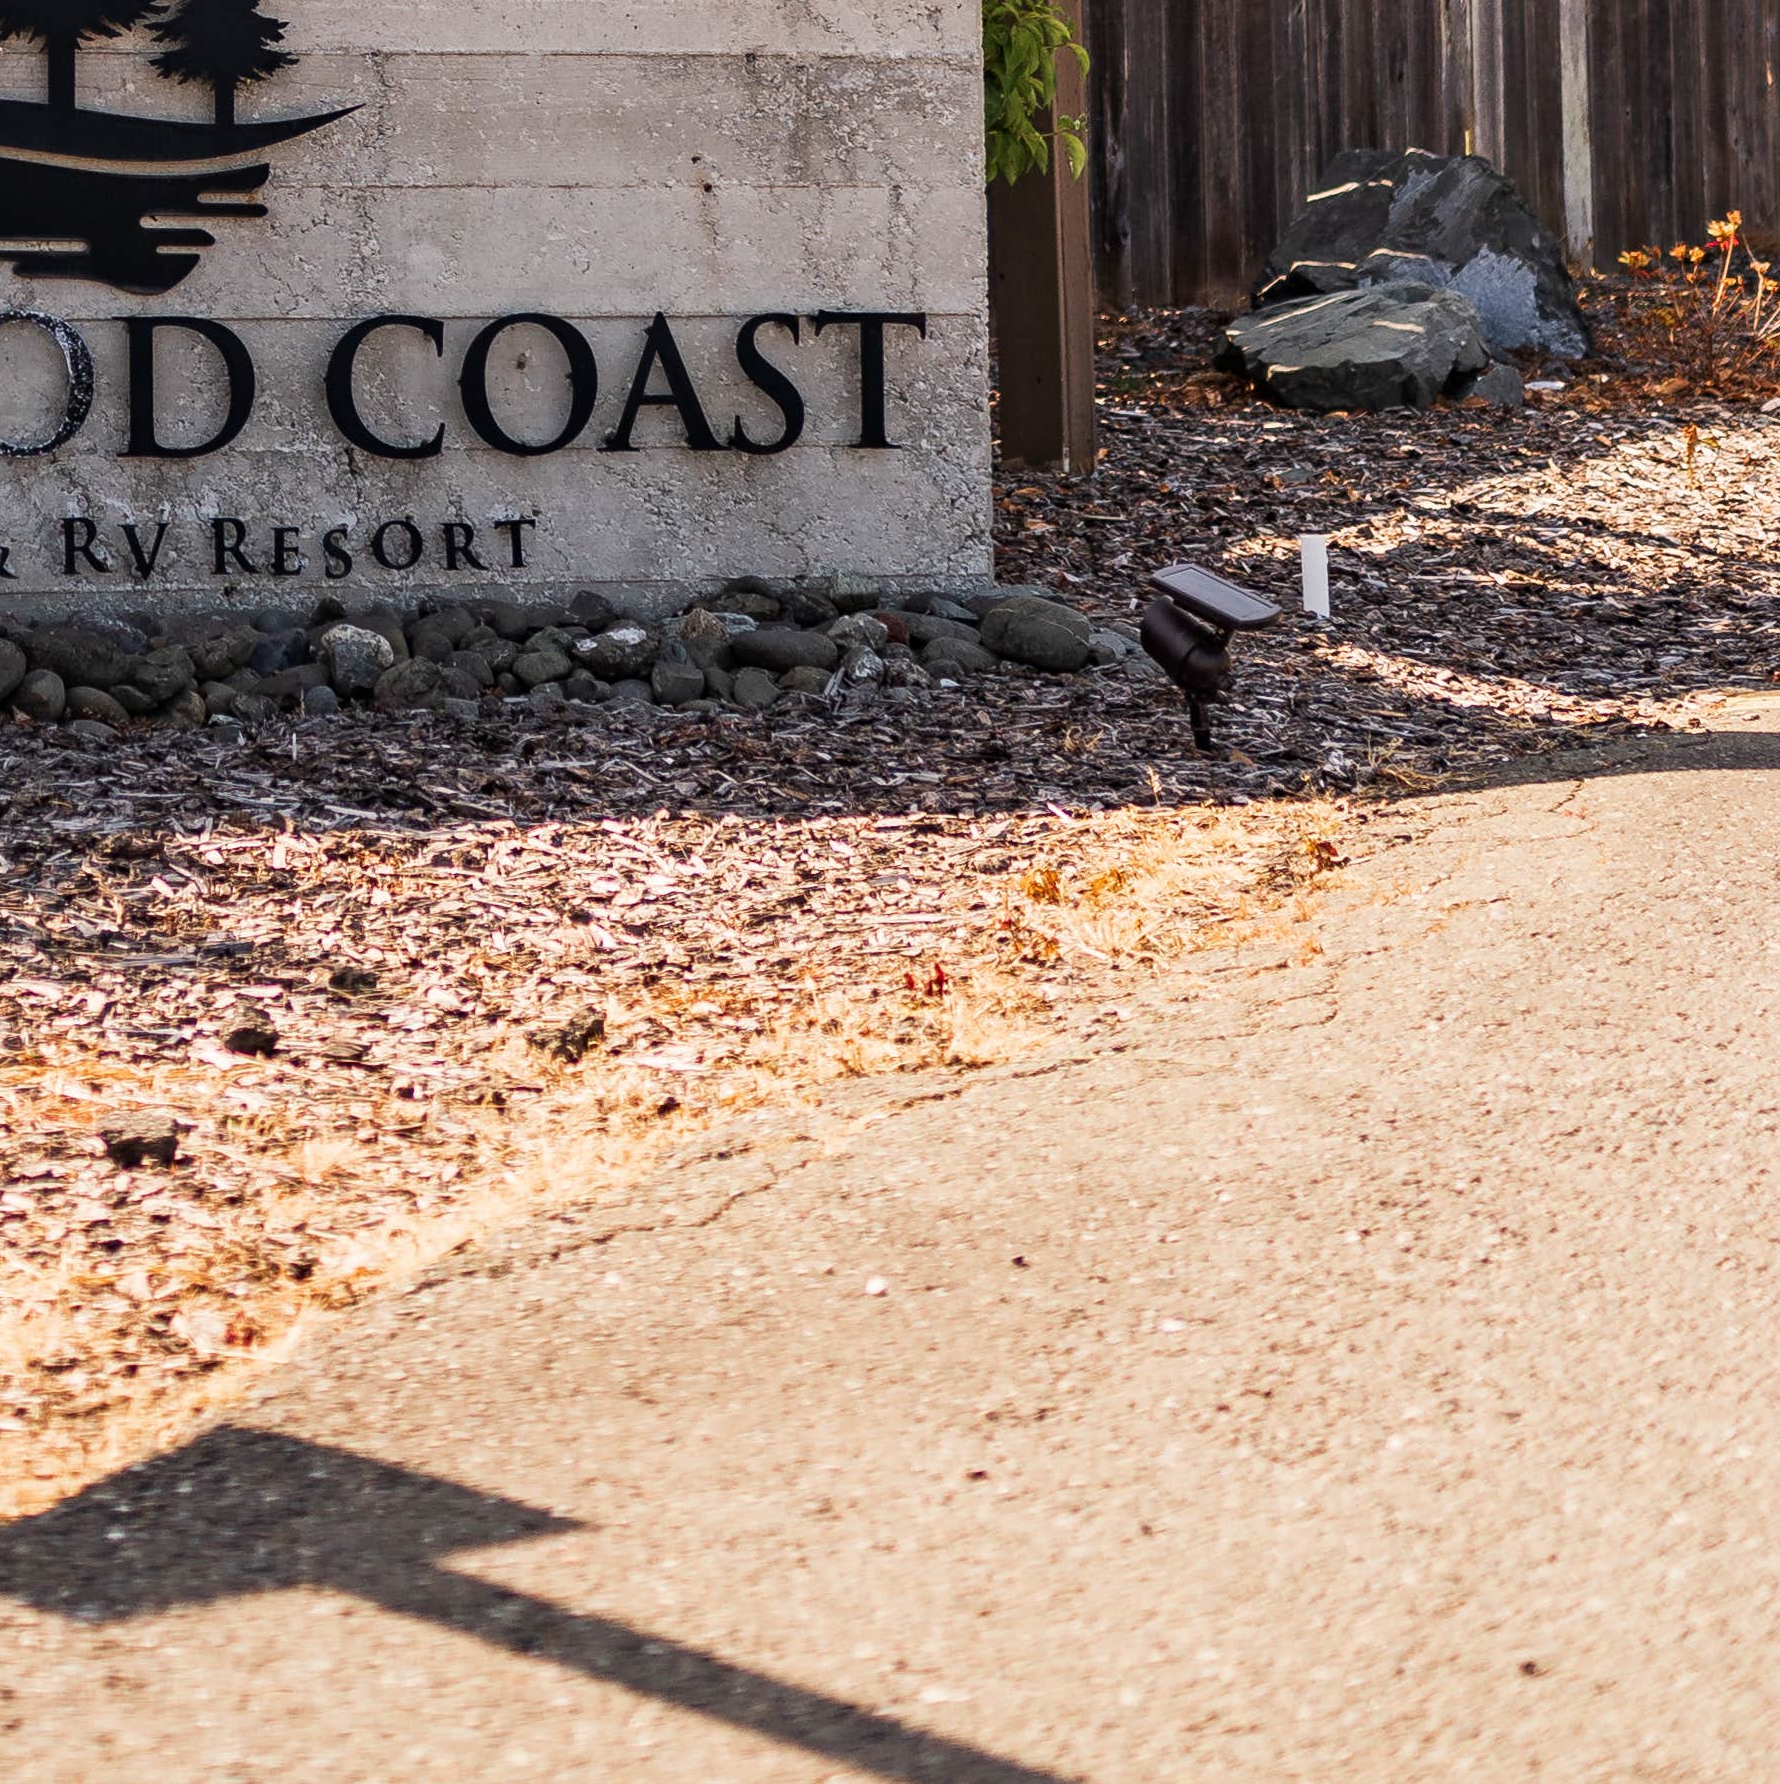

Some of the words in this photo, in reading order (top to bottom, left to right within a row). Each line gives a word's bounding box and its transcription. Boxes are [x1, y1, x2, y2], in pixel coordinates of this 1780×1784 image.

[324, 309, 927, 459] COAST
[60, 516, 168, 581] RV
[211, 516, 538, 579] RESORT
